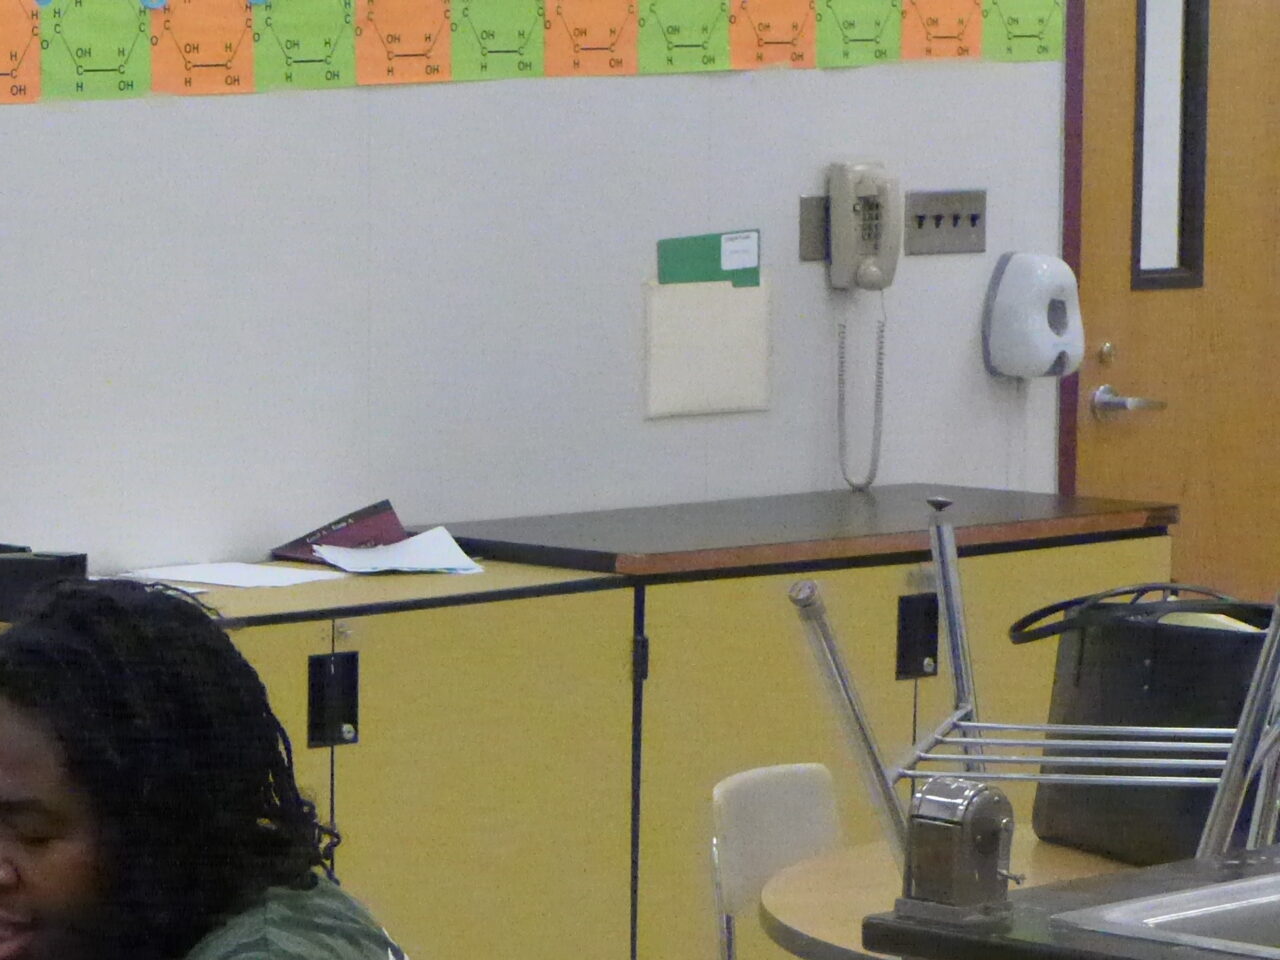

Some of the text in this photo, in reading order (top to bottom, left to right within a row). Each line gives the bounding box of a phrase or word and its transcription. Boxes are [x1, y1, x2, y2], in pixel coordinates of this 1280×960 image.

[245, 4, 251, 12] H
[265, 3, 271, 11] H
[345, 0, 350, 8] H
[54, 10, 60, 18] H
[139, 8, 146, 16] H
[164, 6, 169, 14] H
[444, 10, 450, 19] C
[463, 8, 469, 17] C
[31, 11, 38, 19] H
[345, 15, 350, 24] C
[367, 11, 373, 21] C
[164, 20, 170, 30] C
[246, 19, 252, 28] C
[266, 17, 272, 26] C
[32, 26, 38, 36] C
[54, 24, 61, 34] C
[139, 23, 145, 32] C
[355, 27, 362, 36] O
[451, 23, 457, 31] O
[151, 36, 158, 45] O
[253, 33, 260, 42] O
[387, 34, 400, 43] OH
[425, 34, 431, 42] H
[41, 40, 49, 49] O
[285, 40, 299, 49] OH
[325, 39, 330, 47] H
[185, 44, 199, 53] OH
[225, 44, 231, 52] H
[10, 52, 17, 60] H
[76, 49, 91, 58] OH
[387, 51, 394, 60] C
[425, 50, 431, 58] C
[226, 60, 232, 69] C
[286, 57, 292, 66] C
[325, 56, 331, 64] C
[119, 65, 125, 74] C
[185, 61, 191, 70] C
[425, 65, 439, 74] OH
[10, 70, 17, 79] C
[76, 66, 83, 75] C
[387, 66, 393, 75] H
[286, 72, 292, 81] H
[325, 71, 339, 80] OH
[185, 78, 191, 86] H
[225, 76, 240, 85] OH
[76, 82, 83, 91] H
[119, 81, 133, 90] OH
[10, 86, 26, 95] OH
